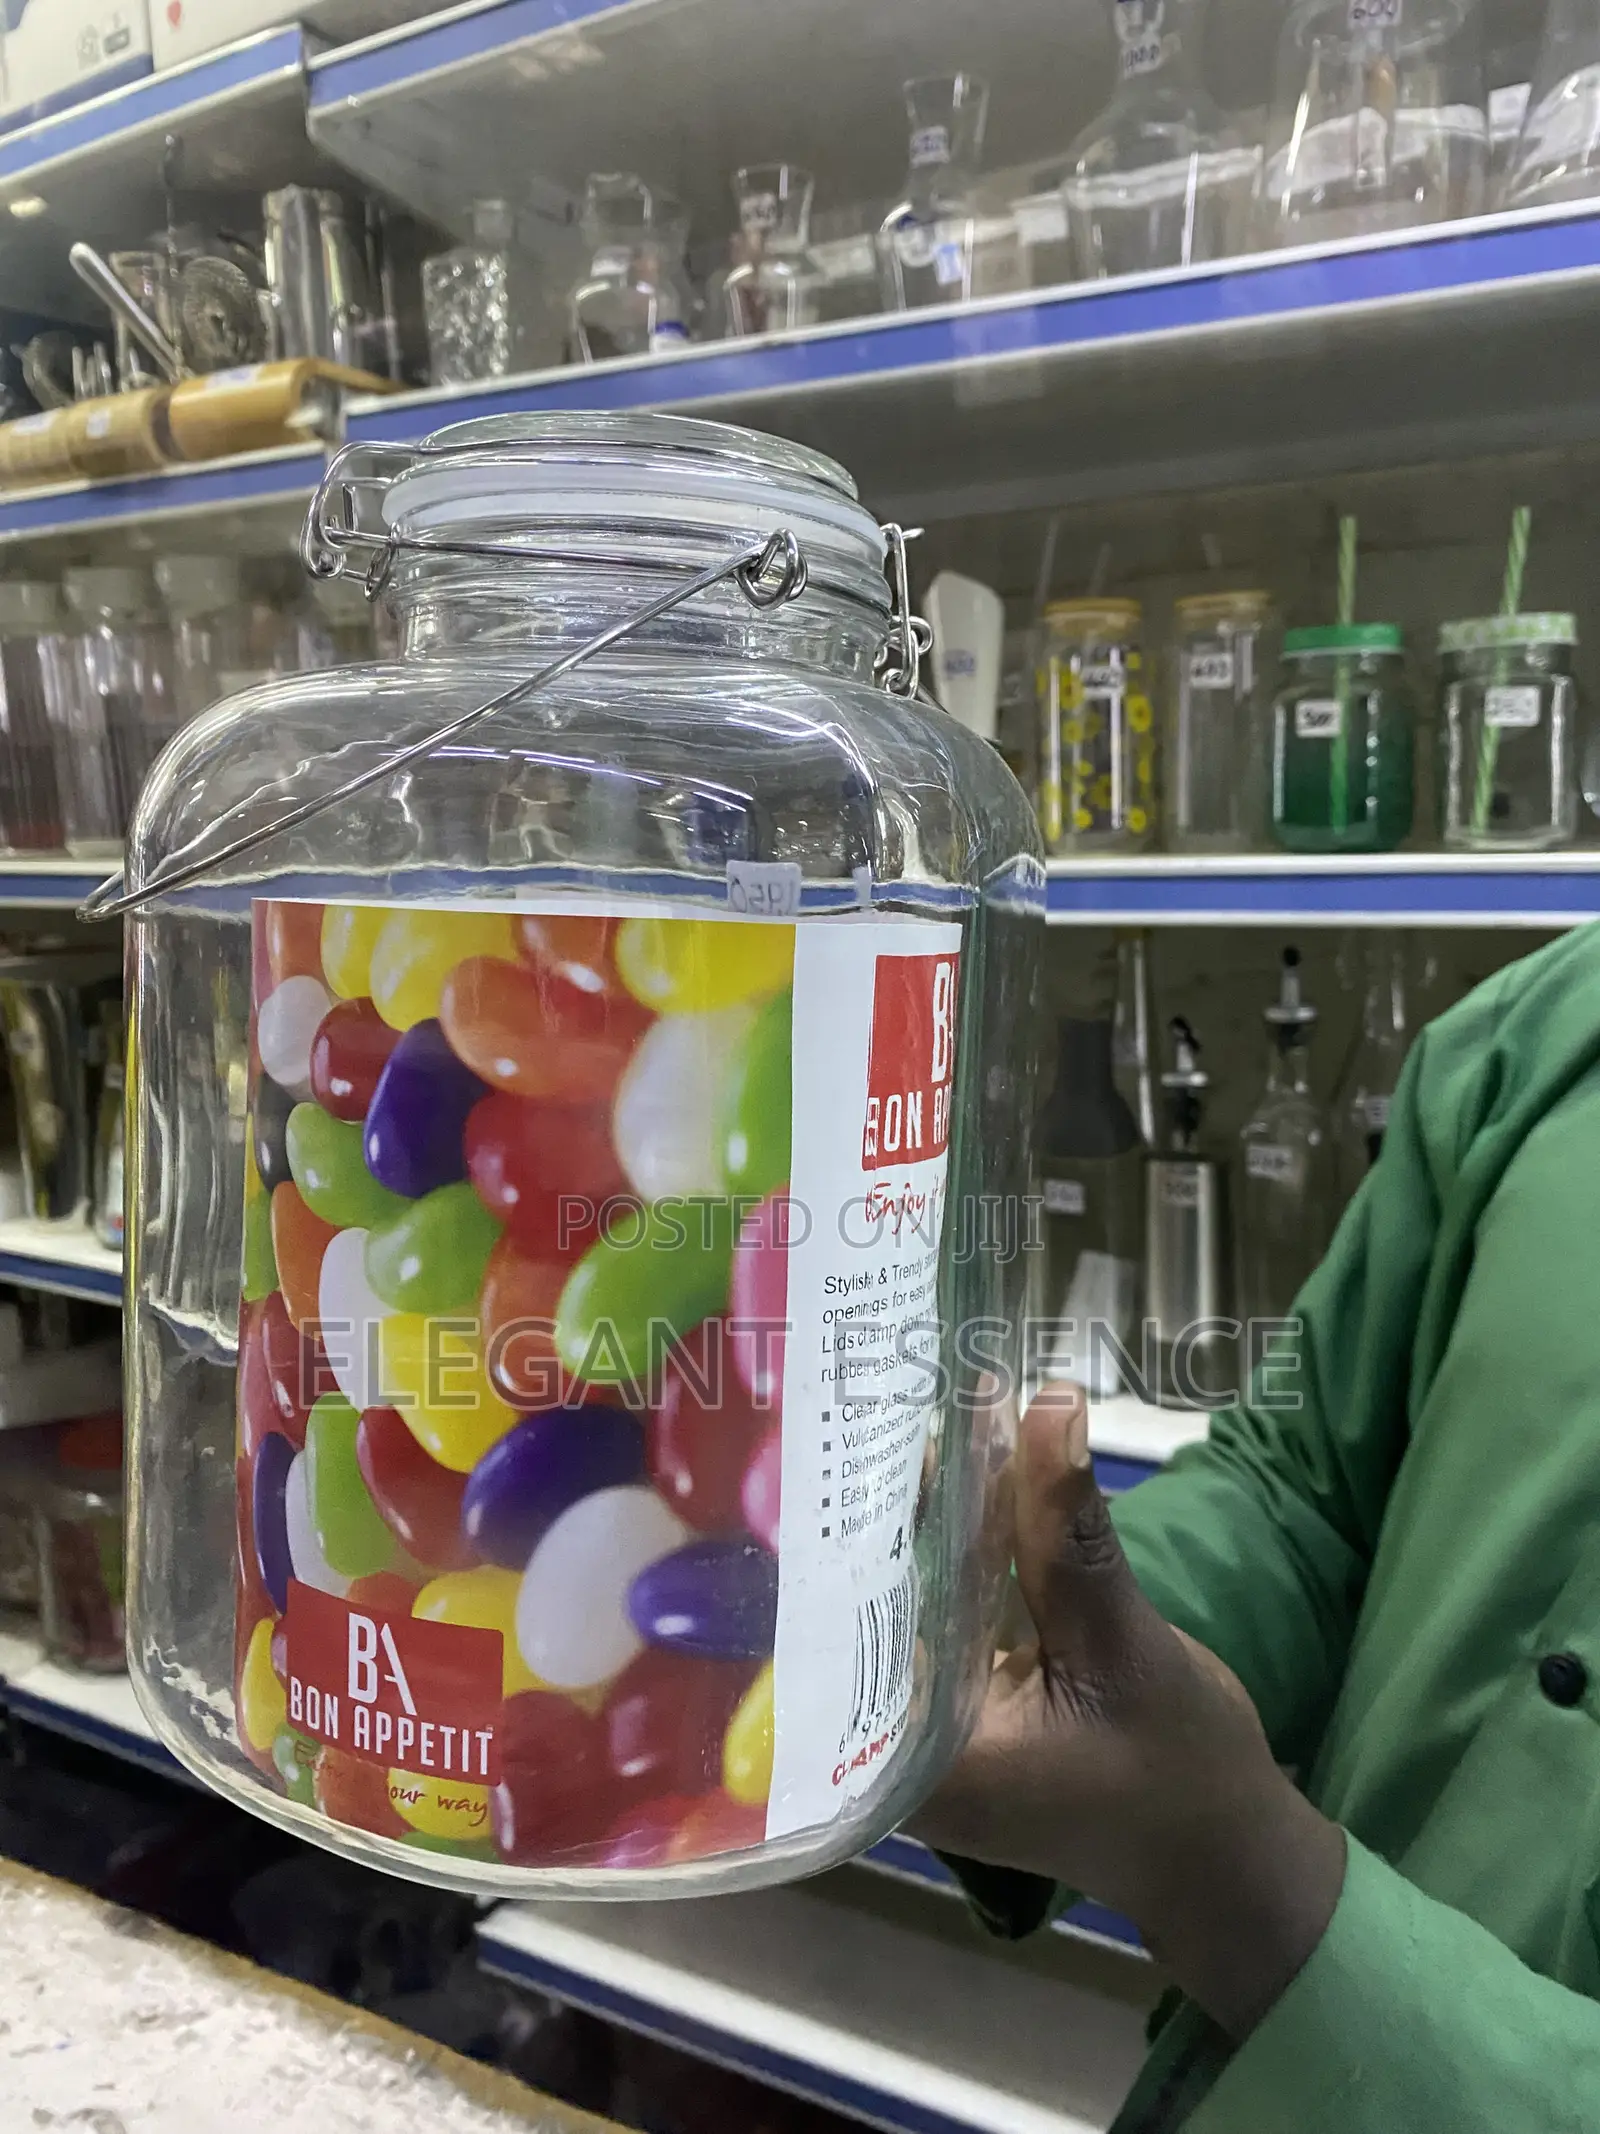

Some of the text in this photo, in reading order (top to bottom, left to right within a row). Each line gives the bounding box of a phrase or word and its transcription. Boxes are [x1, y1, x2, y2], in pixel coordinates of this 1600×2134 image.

[878, 1266, 888, 1285] &
[892, 1255, 924, 1282] Trendy
[822, 1297, 889, 1328] openings
[892, 1290, 908, 1309] for
[909, 1284, 927, 1302] easy
[822, 1331, 855, 1354] Lids
[857, 1322, 898, 1347] clamp
[873, 1344, 918, 1377] gaskets
[842, 1400, 877, 1422] Clear
[881, 1388, 909, 1415] glass
[842, 1412, 905, 1450] Vulcanized
[842, 1484, 870, 1508] Easy
[290, 1676, 338, 1739] BON
[354, 1704, 493, 1776] APPETIT
[437, 1794, 489, 1827] way
